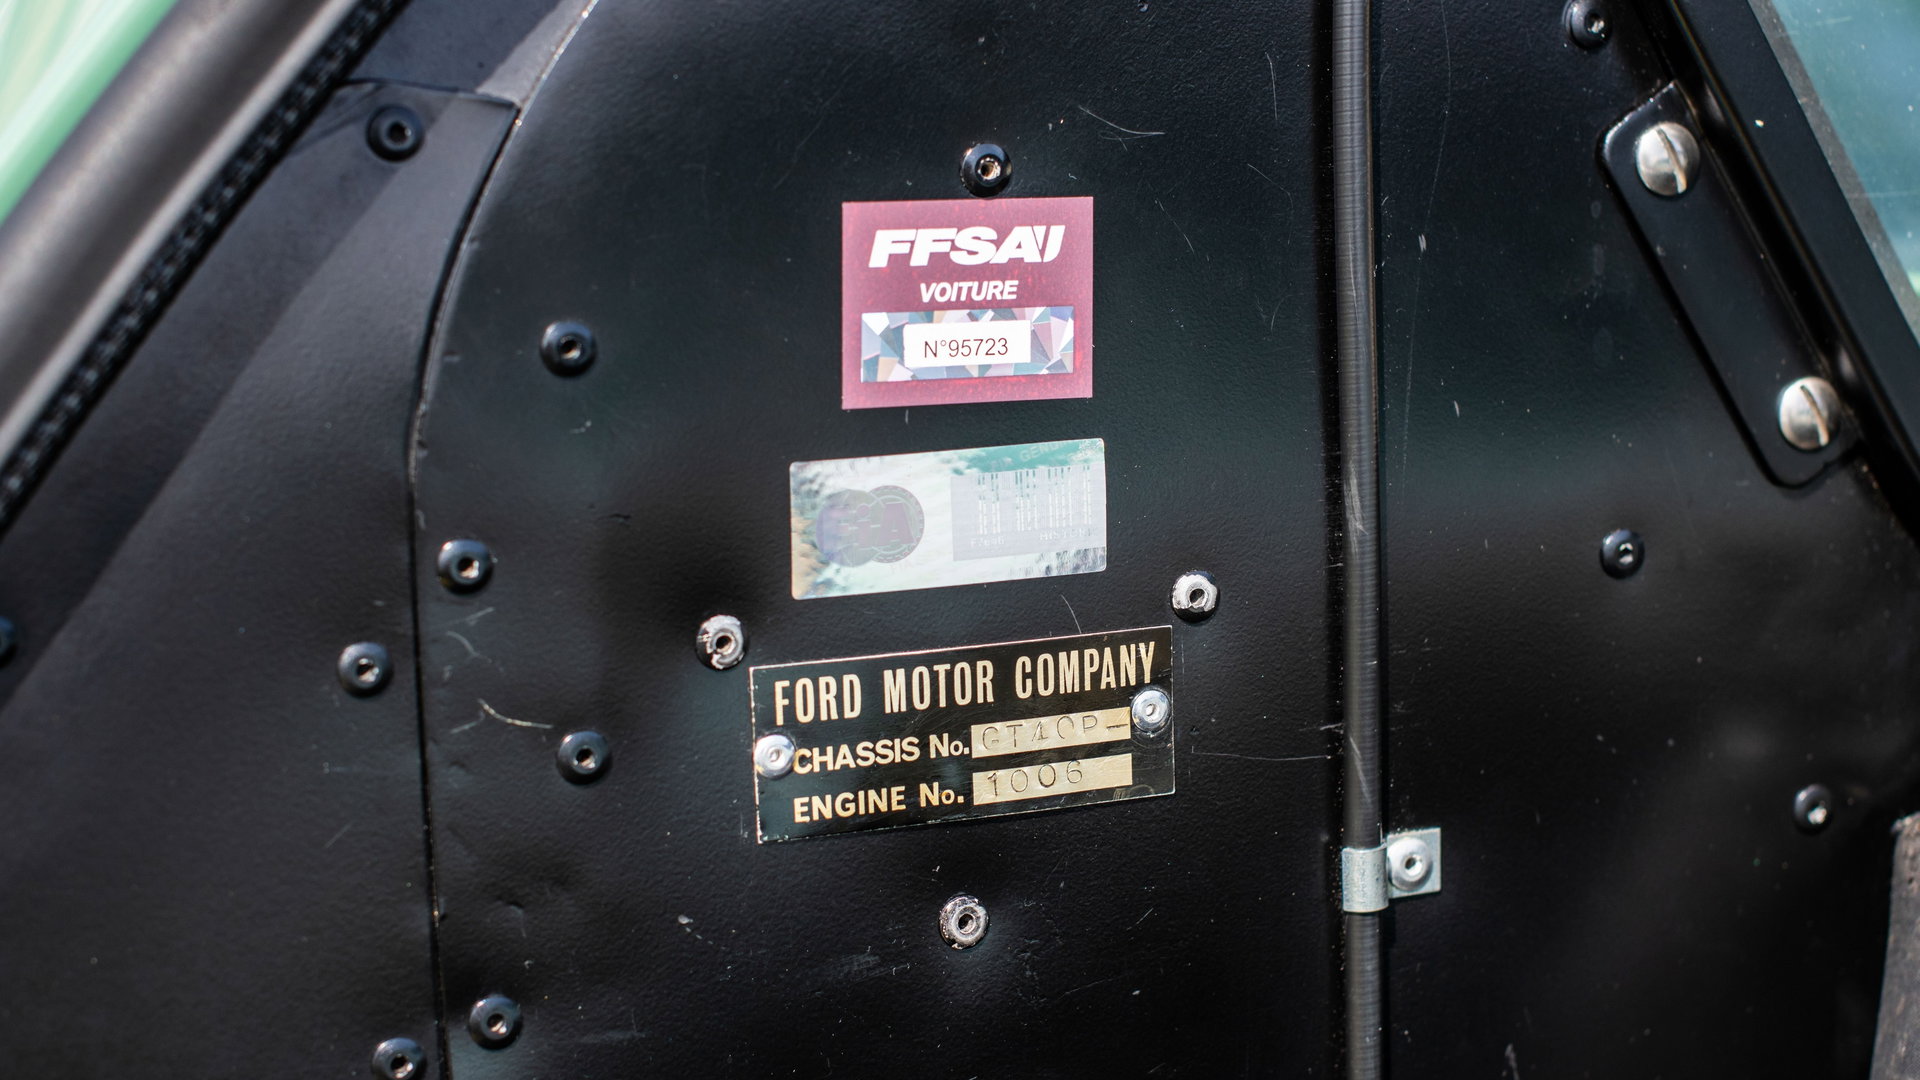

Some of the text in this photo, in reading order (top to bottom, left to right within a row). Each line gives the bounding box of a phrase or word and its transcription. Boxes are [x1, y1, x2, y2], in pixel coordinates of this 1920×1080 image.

[868, 225, 1048, 268] FFSA
[920, 280, 1019, 303] VOITURE
[923, 337, 1009, 359] N°95723
[773, 640, 1156, 726] FORD MOTOR COMPANY
[792, 736, 920, 775] CHASSIS
[929, 732, 970, 759] No.
[793, 759, 1084, 824] ENGINE No. 1006
